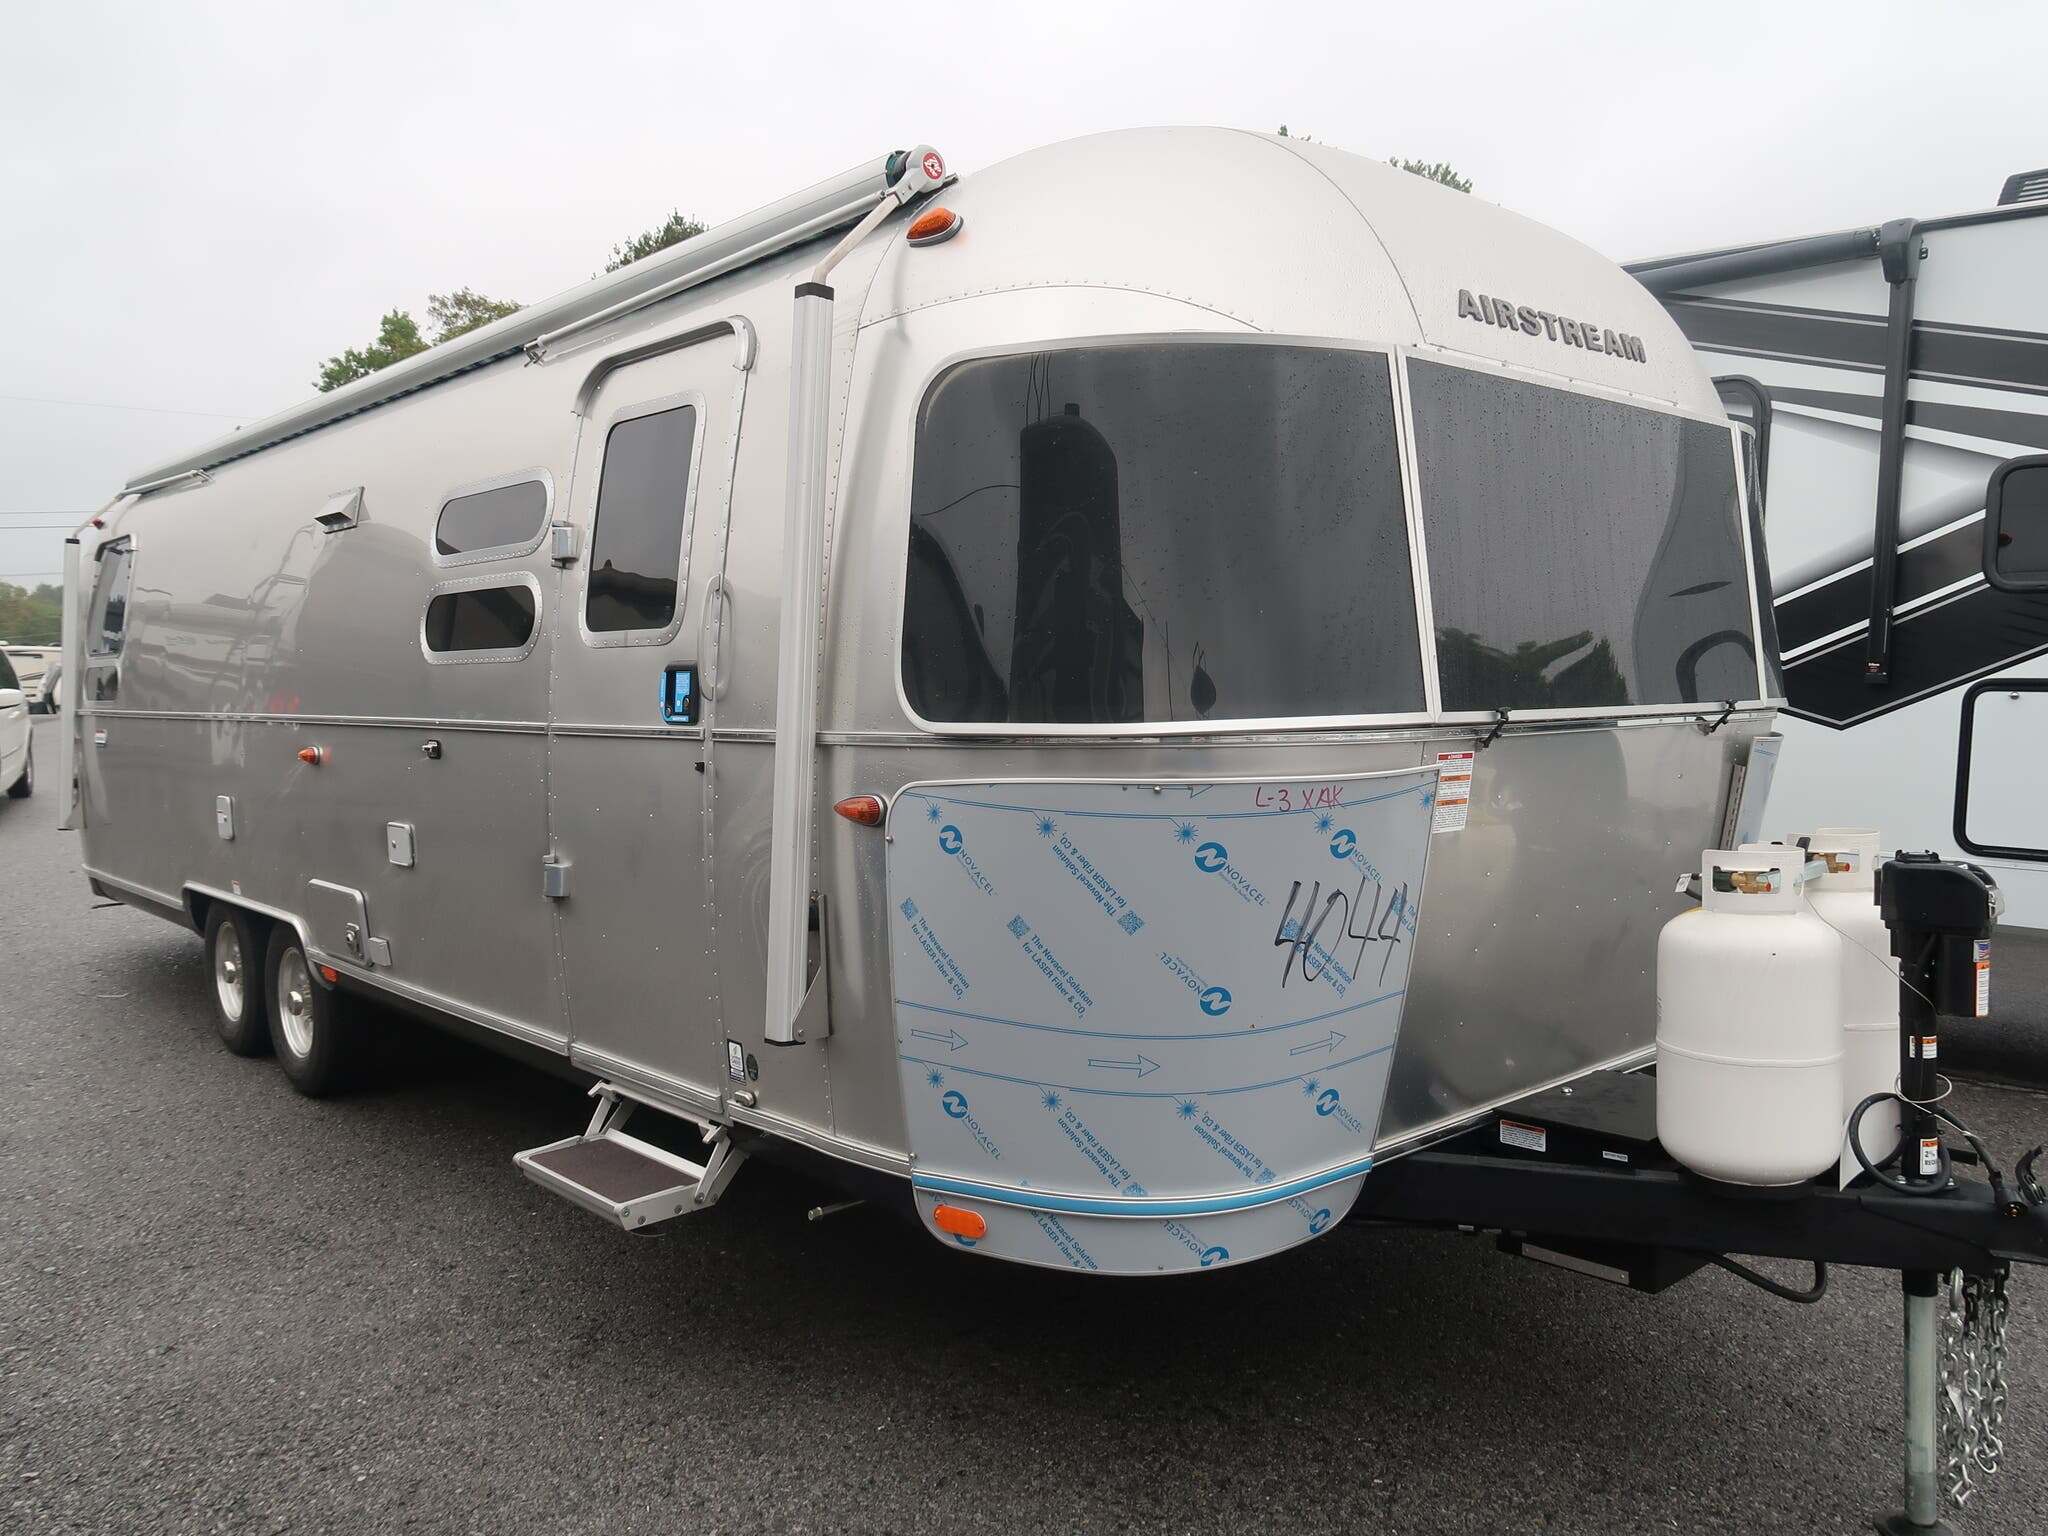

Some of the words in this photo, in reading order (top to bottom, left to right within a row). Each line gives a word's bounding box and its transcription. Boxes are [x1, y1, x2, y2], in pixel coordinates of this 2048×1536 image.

[1458, 289, 1646, 364] AIRSTREAM
[959, 849, 994, 896] NOVACEL
[1052, 844, 1079, 876] Solution
[1076, 854, 1095, 874] Fiber
[1353, 850, 1384, 881] NOVACEL
[1076, 875, 1104, 903] Novacel
[1091, 872, 1117, 898] LASER
[1224, 864, 1265, 906] NOVACEL
[1104, 901, 1117, 916] The
[1116, 896, 1128, 909] for
[911, 923, 920, 935] for
[918, 934, 936, 961] LASER
[934, 957, 950, 979] Fiber
[918, 917, 929, 931] The
[927, 929, 950, 960] Novacel
[948, 958, 970, 989] Solution
[1022, 942, 1033, 954] for
[1031, 952, 1054, 980] LASER
[1052, 976, 1070, 997] Fiber
[1031, 934, 1043, 950] The
[1043, 948, 1067, 977] Novacel
[1066, 975, 1094, 1007] Solution
[1160, 952, 1203, 995] NOVACEL
[1058, 1117, 1084, 1149] Solution
[1336, 1104, 1361, 1133] NOVACEL
[964, 1115, 1002, 1160] NOVACEL
[1081, 1127, 1099, 1146] Fiber
[1194, 1124, 1220, 1151] Solution
[1218, 1129, 1236, 1145] Fiber
[1080, 1146, 1109, 1175] Novacel
[1096, 1142, 1121, 1171] LASER
[1218, 1146, 1244, 1169] Novacel
[1233, 1142, 1255, 1161] LASER
[1253, 1158, 1264, 1169] for
[1107, 1171, 1121, 1188] The
[1119, 1166, 1132, 1181] for
[1242, 1165, 1254, 1178] The
[1038, 1217, 1059, 1242] LASER
[1057, 1241, 1074, 1261] Fiber
[1048, 1214, 1074, 1243] Novacel
[1072, 1241, 1098, 1270] Solution
[1163, 1219, 1204, 1256] NOVACEL
